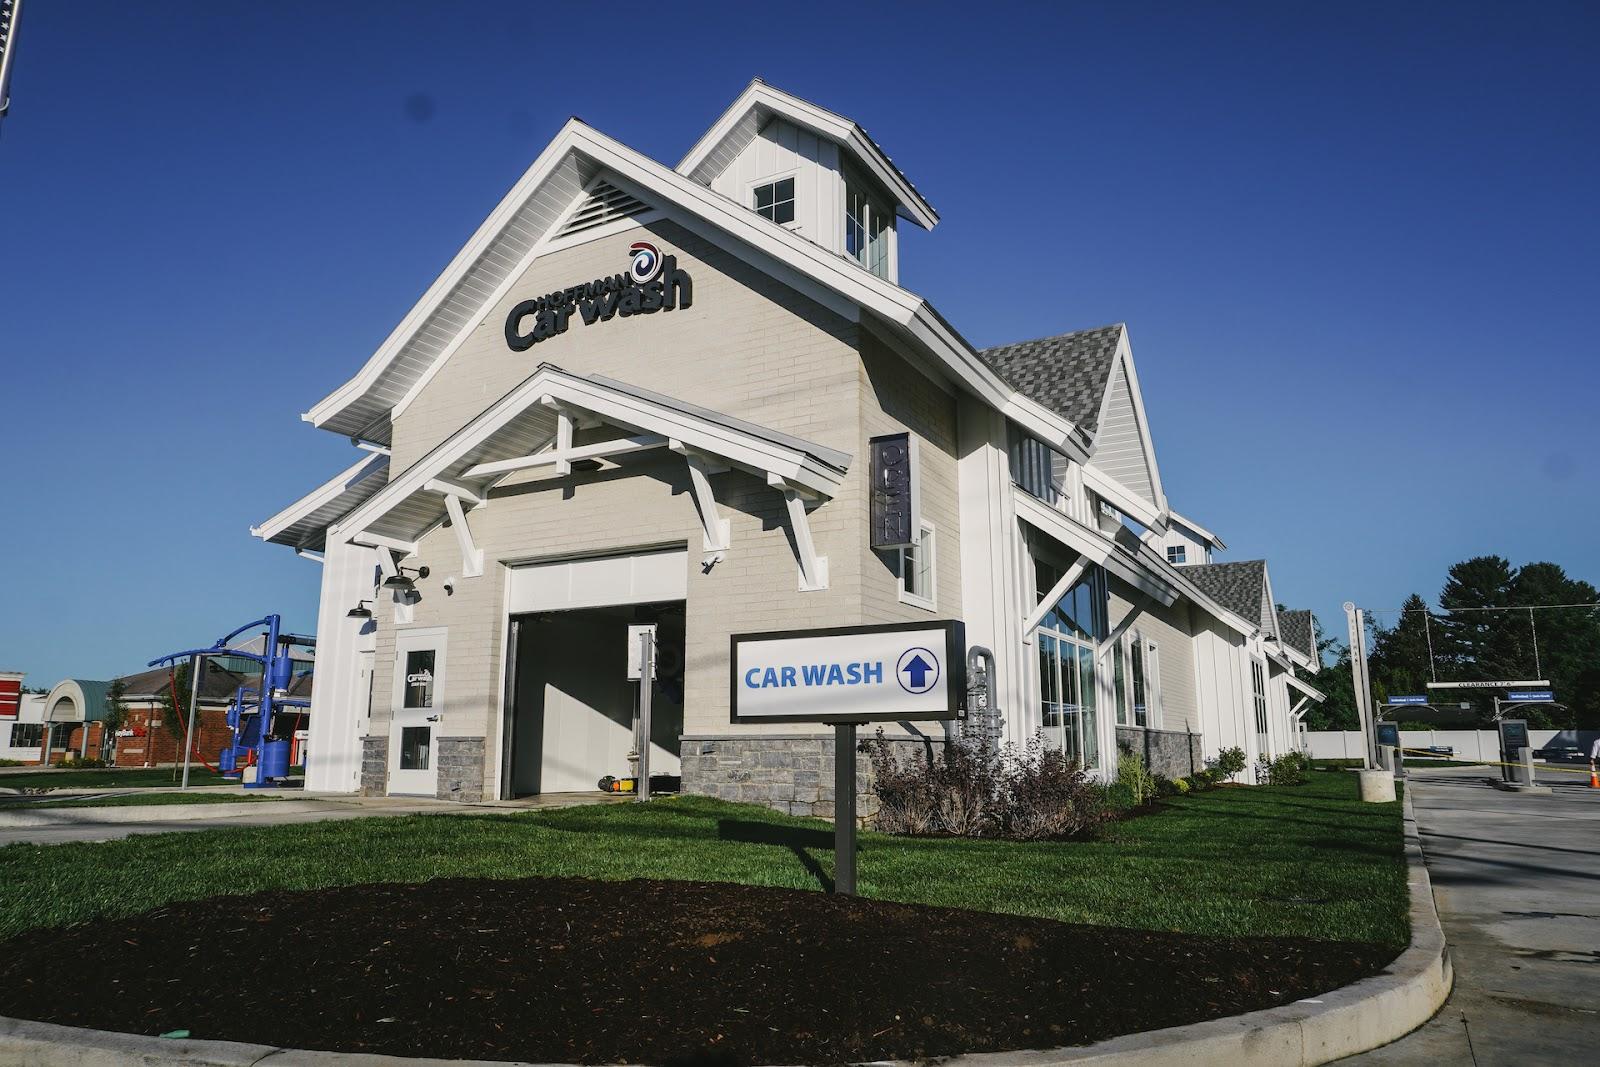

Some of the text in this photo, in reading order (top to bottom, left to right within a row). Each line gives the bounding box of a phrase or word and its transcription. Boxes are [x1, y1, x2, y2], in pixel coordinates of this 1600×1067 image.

[505, 255, 692, 352] Car wash
[537, 272, 631, 311] HOFFMAN
[881, 445, 904, 542] OPEN
[745, 661, 882, 689] CAR WASH
